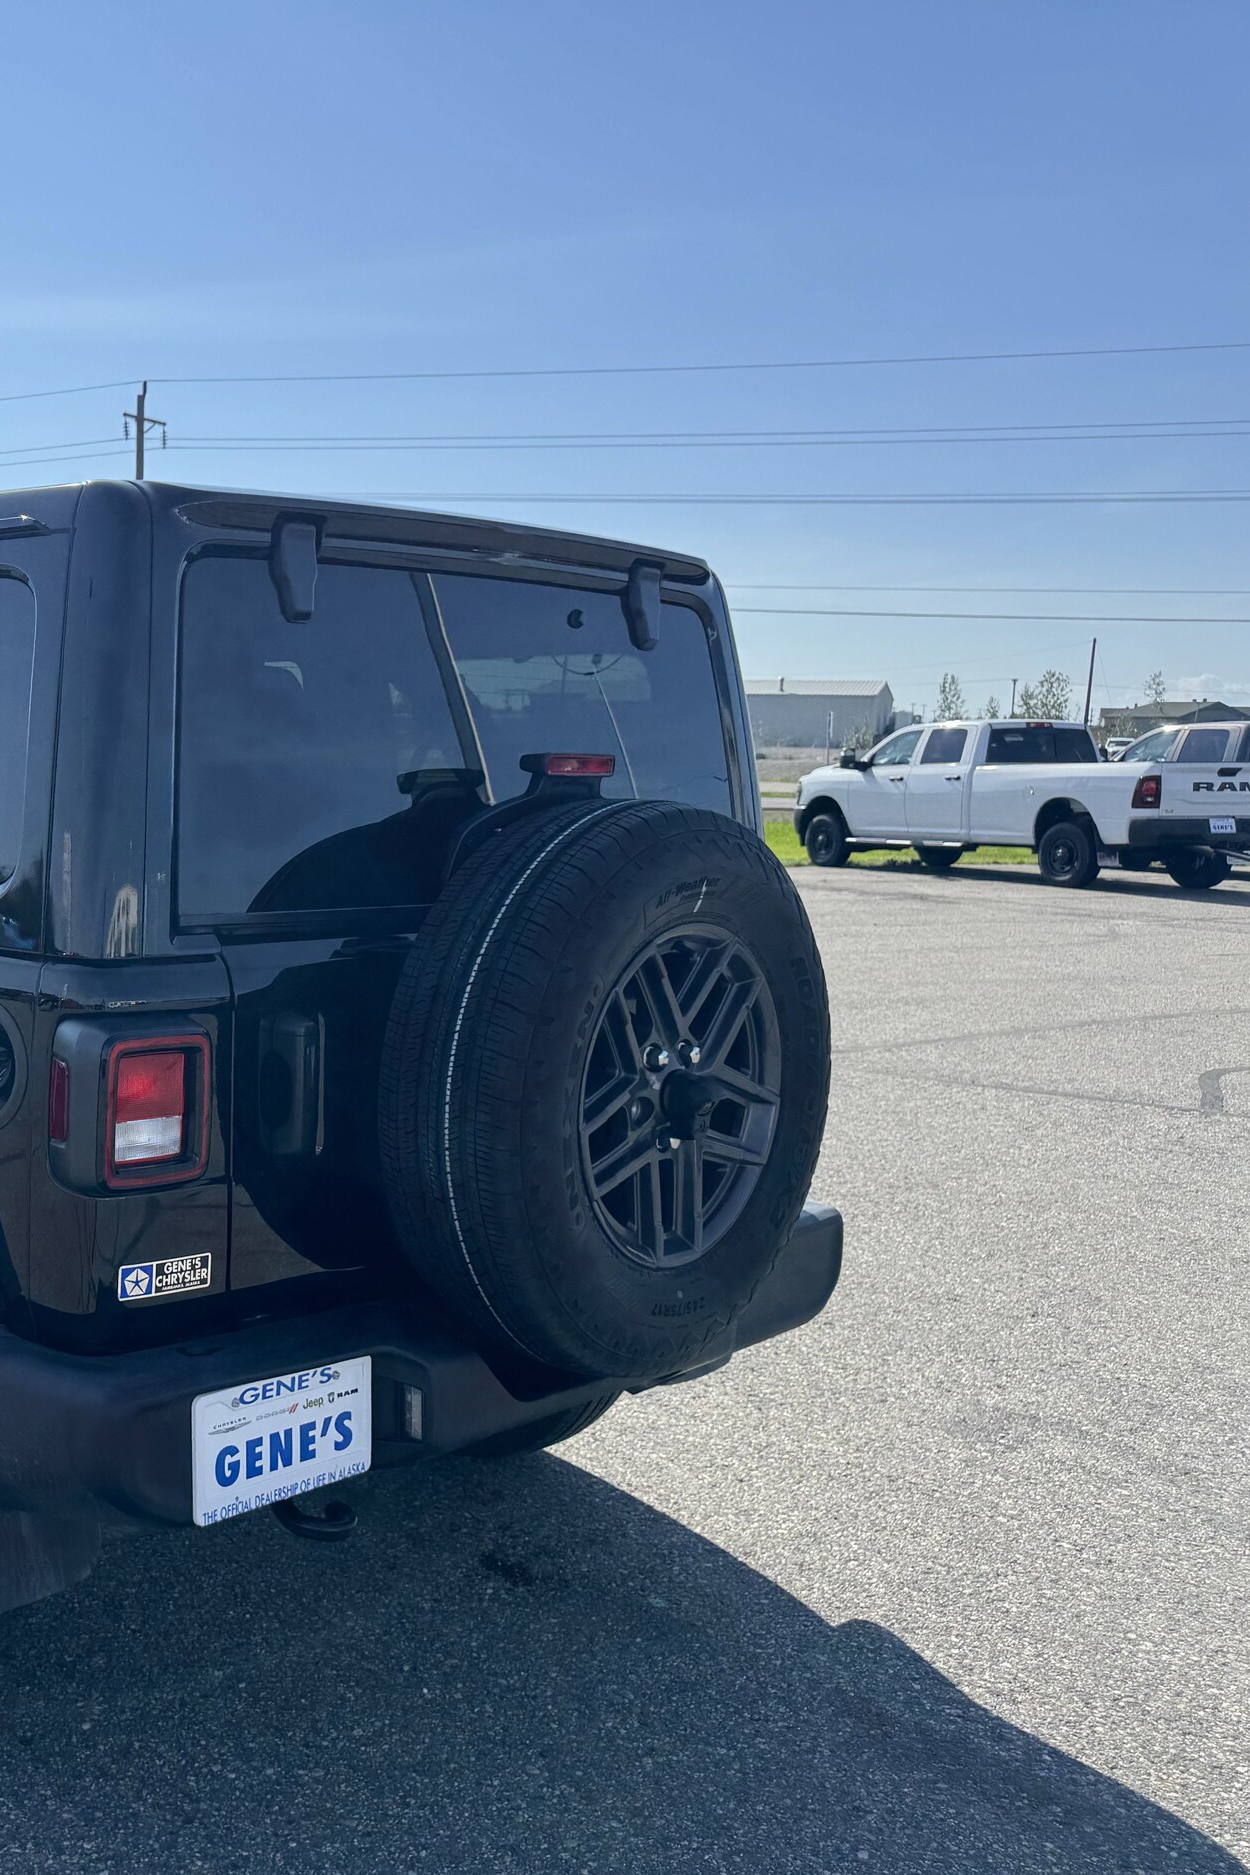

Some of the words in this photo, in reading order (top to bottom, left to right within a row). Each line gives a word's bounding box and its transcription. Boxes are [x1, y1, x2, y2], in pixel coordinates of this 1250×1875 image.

[561, 1000, 595, 1211] NEXEN
[163, 1257, 202, 1274] GENE'S
[155, 1267, 208, 1287] CHRYSLER
[238, 1366, 334, 1405] GENE'S
[336, 1387, 359, 1398] RAM
[302, 1397, 324, 1410] Jeep
[213, 1416, 247, 1430] CHRYSLER
[214, 1410, 354, 1488] GENE'S
[202, 1509, 218, 1526] THE
[220, 1498, 254, 1519] OFFICIAL
[254, 1482, 299, 1508] DEALERSHIP
[300, 1478, 311, 1492] OF
[312, 1472, 327, 1489] LIFE
[327, 1471, 337, 1482] IN
[338, 1461, 366, 1479] ALASKA
